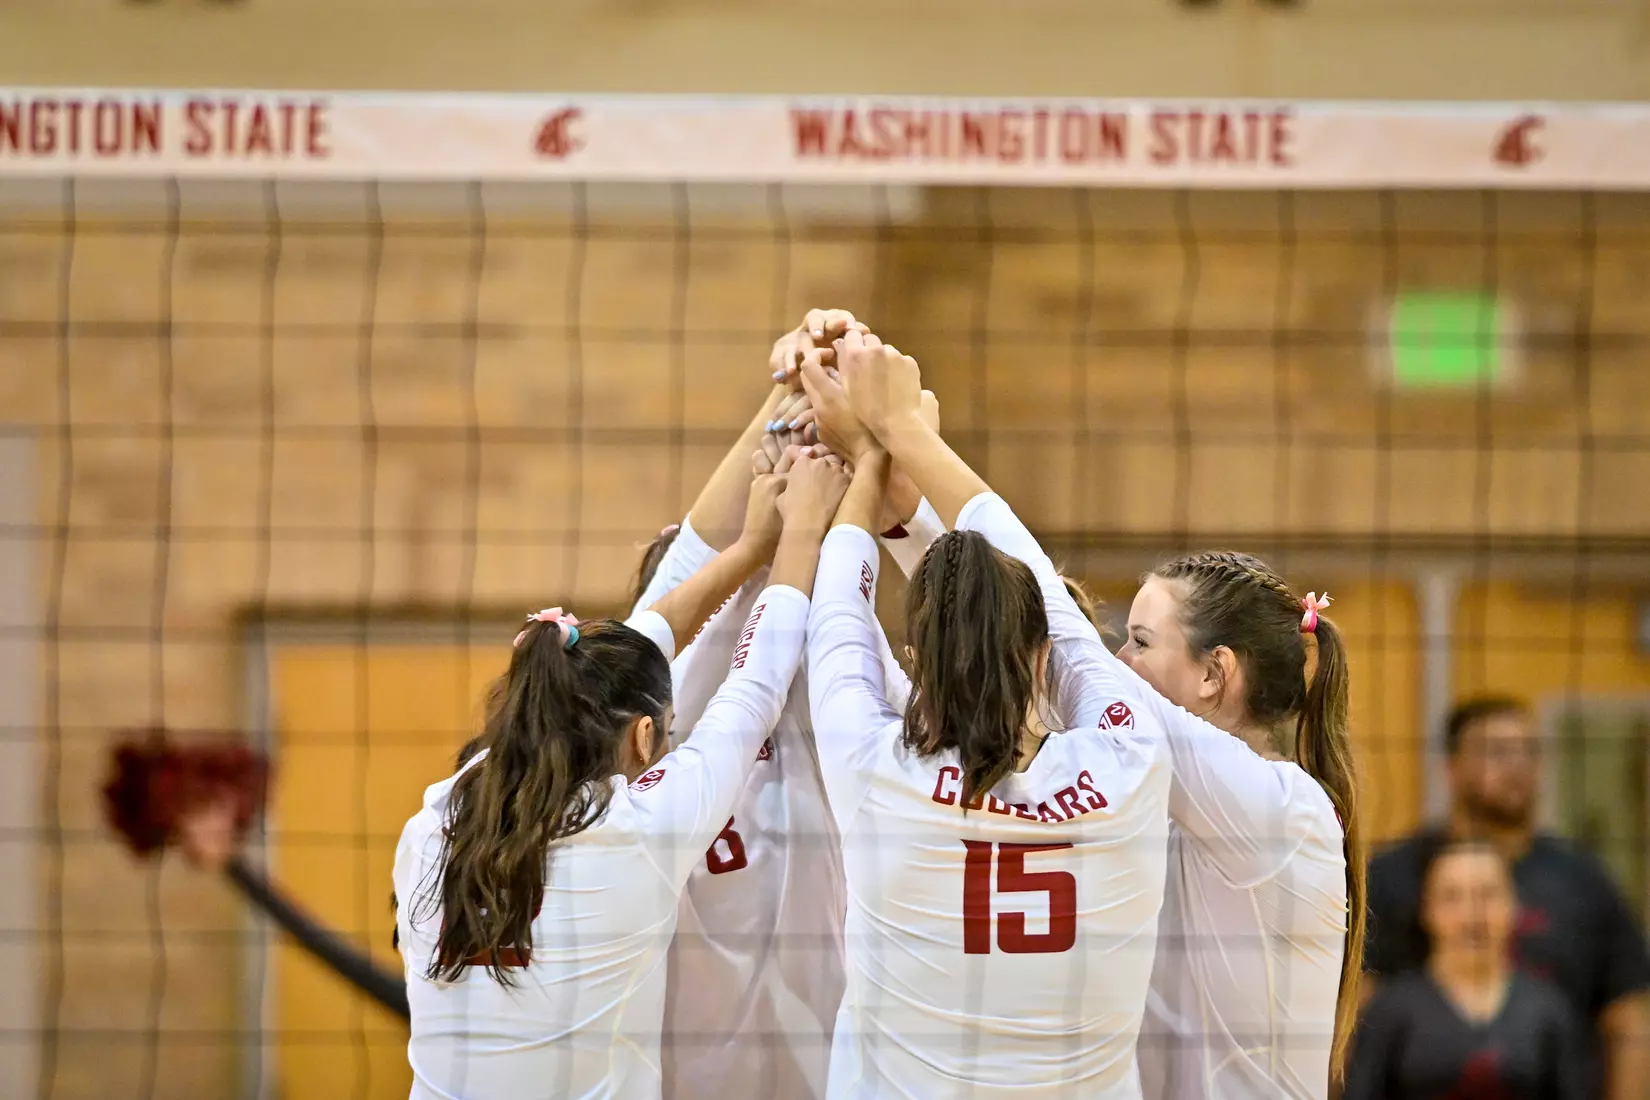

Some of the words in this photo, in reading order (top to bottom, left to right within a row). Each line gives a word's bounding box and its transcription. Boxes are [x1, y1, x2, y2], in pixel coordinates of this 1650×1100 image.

[183, 101, 328, 157] STATE
[790, 109, 1129, 165] WASHINGTON
[1149, 110, 1289, 166] STATE
[961, 838, 1077, 955] 15
